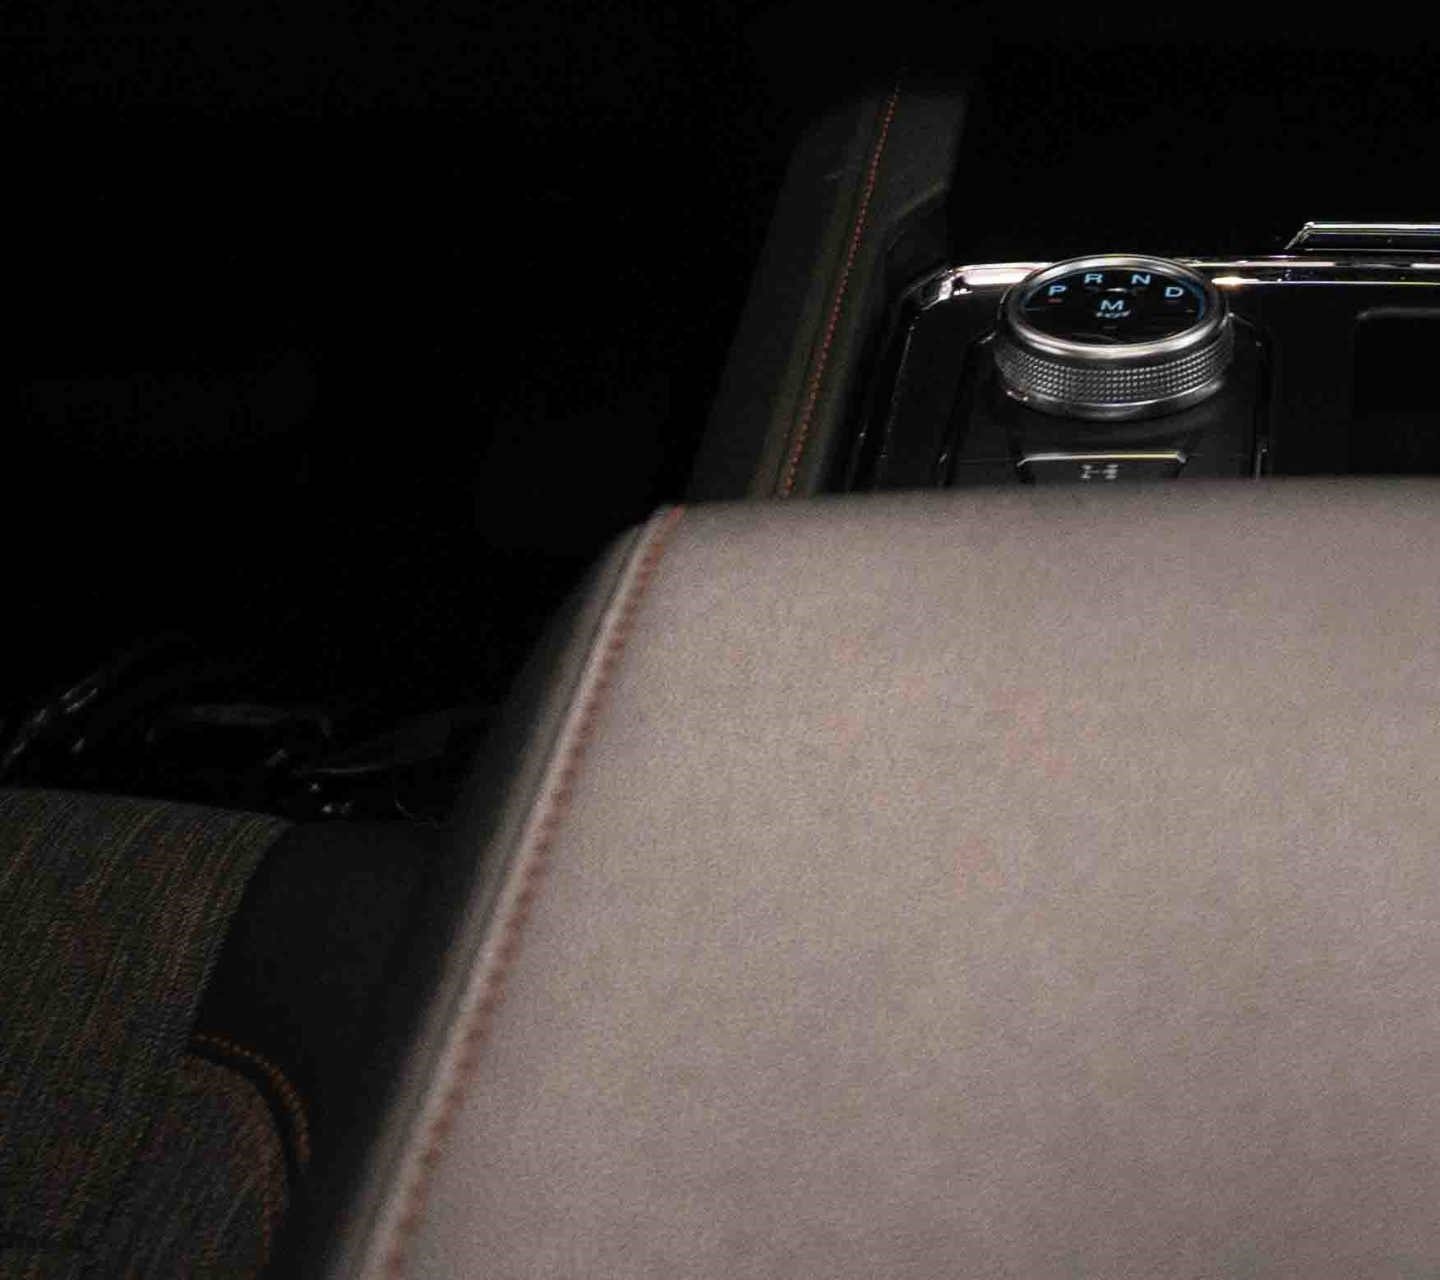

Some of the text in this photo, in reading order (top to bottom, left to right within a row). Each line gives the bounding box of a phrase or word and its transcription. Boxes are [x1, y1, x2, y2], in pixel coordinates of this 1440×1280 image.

[1084, 273, 1104, 285] R
[1131, 274, 1152, 285] N
[1048, 285, 1067, 297] P
[1164, 286, 1185, 298] D
[1100, 299, 1125, 312] M
